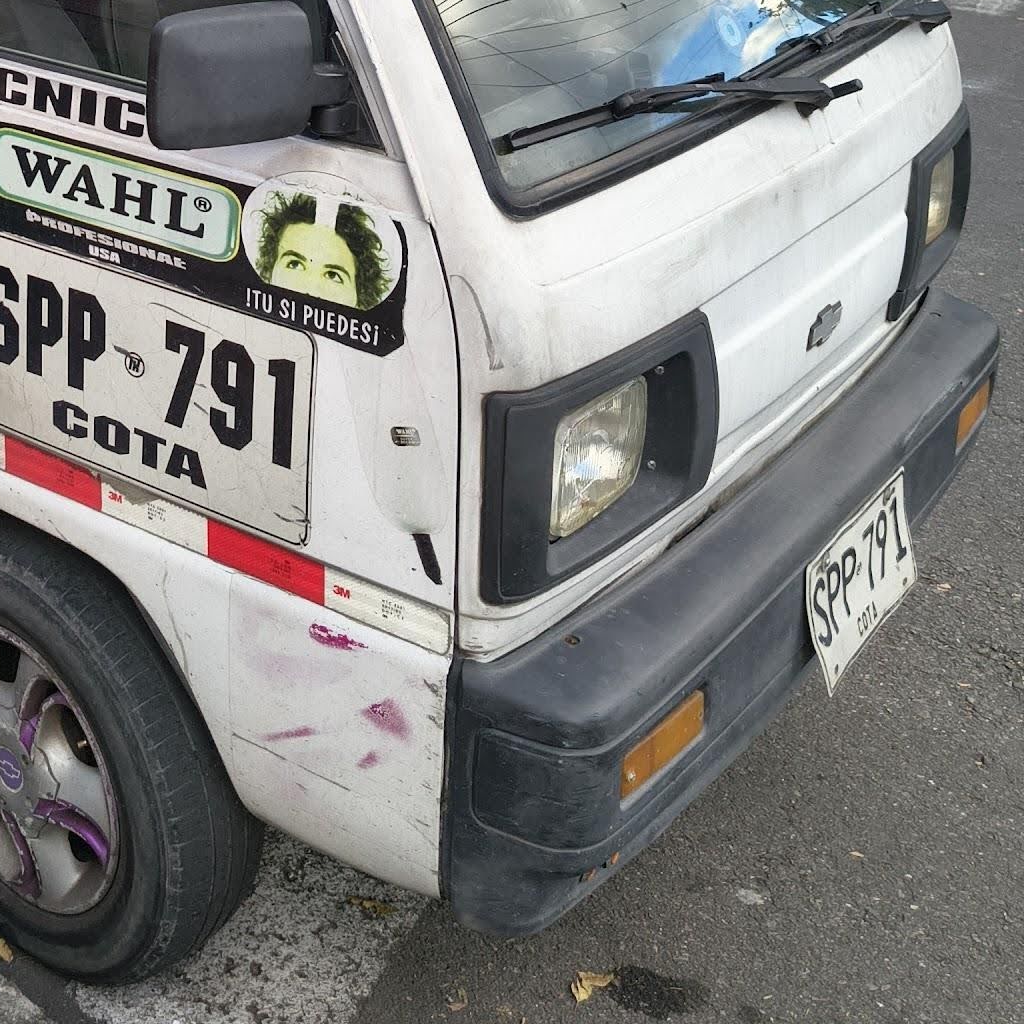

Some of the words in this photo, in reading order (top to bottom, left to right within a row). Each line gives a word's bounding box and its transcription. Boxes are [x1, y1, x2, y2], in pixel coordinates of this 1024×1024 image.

[88, 244, 121, 264] USA
[279, 298, 296, 321] SI
[164, 319, 296, 470] 791
[52, 399, 208, 490] COTA
[107, 491, 123, 504] 3M
[813, 546, 857, 647] SPP
[862, 496, 908, 592] 791
[332, 584, 351, 600] 3M
[856, 601, 878, 638] COTA
